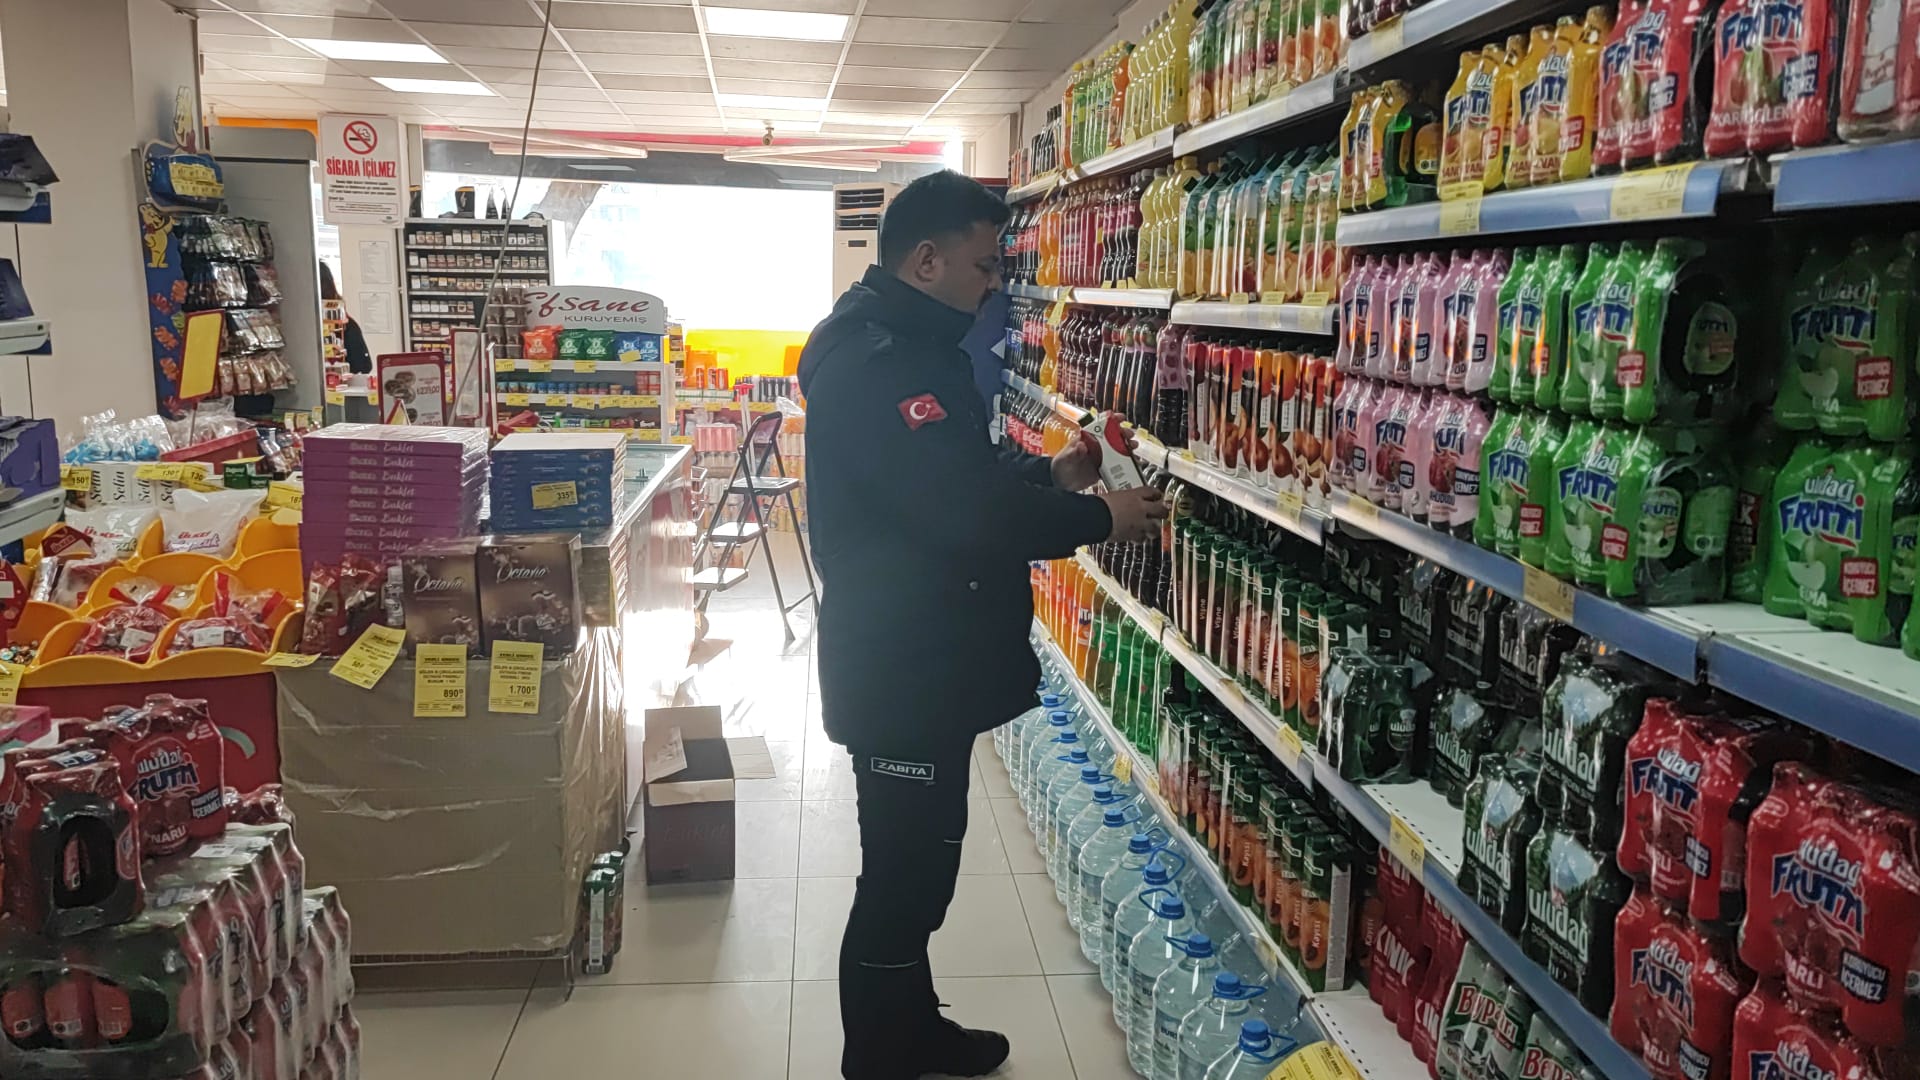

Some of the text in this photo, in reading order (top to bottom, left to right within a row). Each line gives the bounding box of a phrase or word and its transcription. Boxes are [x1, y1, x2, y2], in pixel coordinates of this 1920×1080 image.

[326, 157, 397, 179] SİGARA İÇİLMEZ
[564, 315, 648, 325] KURUYEMİŞ
[113, 471, 125, 501] Selin
[876, 761, 927, 776] ZABITA
[1528, 887, 1588, 963] uludağ
